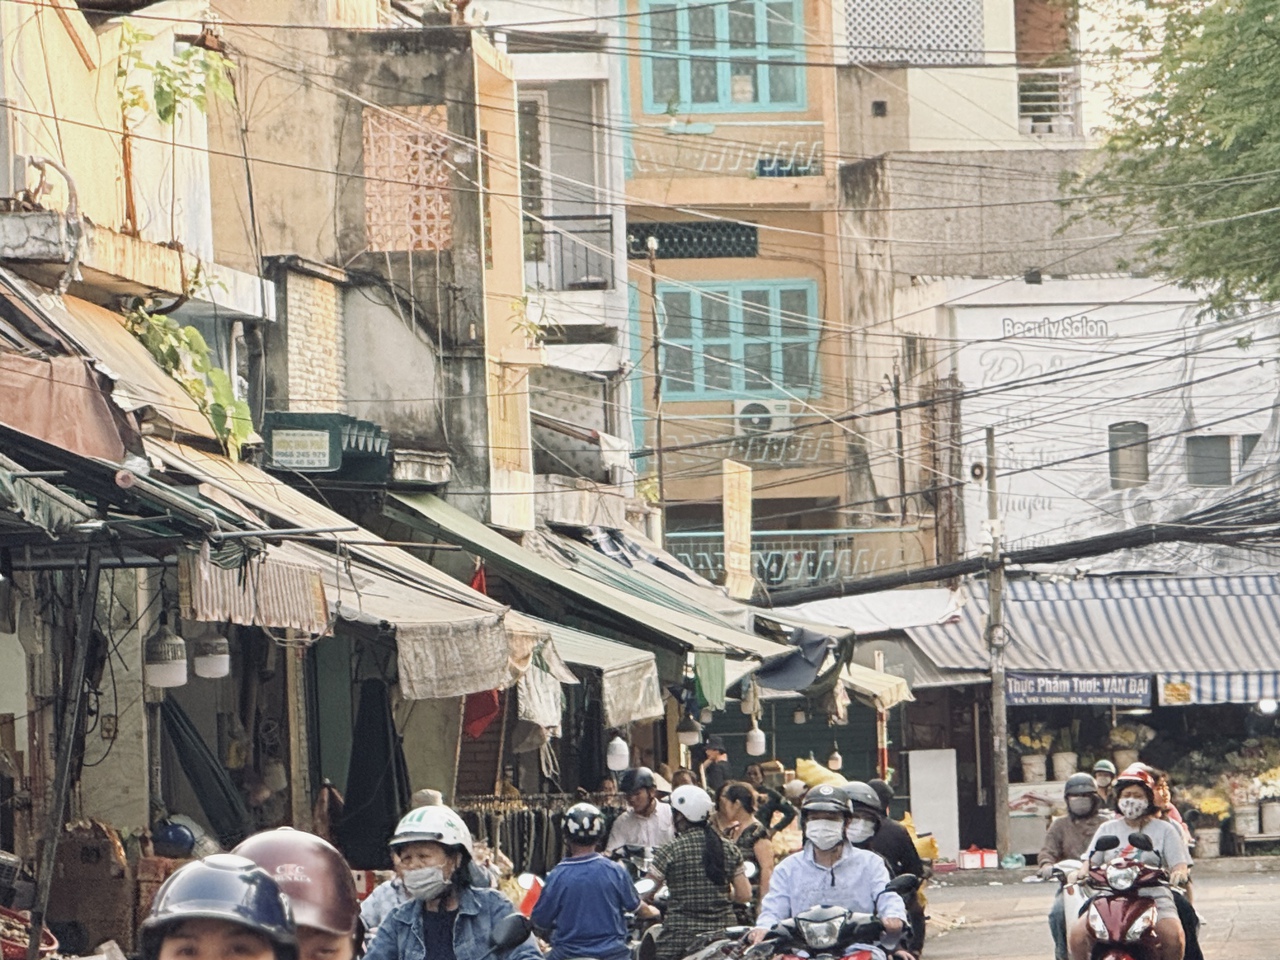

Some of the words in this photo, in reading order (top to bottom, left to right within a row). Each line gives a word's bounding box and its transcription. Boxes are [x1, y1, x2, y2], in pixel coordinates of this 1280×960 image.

[1002, 317, 1061, 338] Beauty
[1063, 316, 1108, 338] Salon
[1006, 677, 1035, 697] Thực
